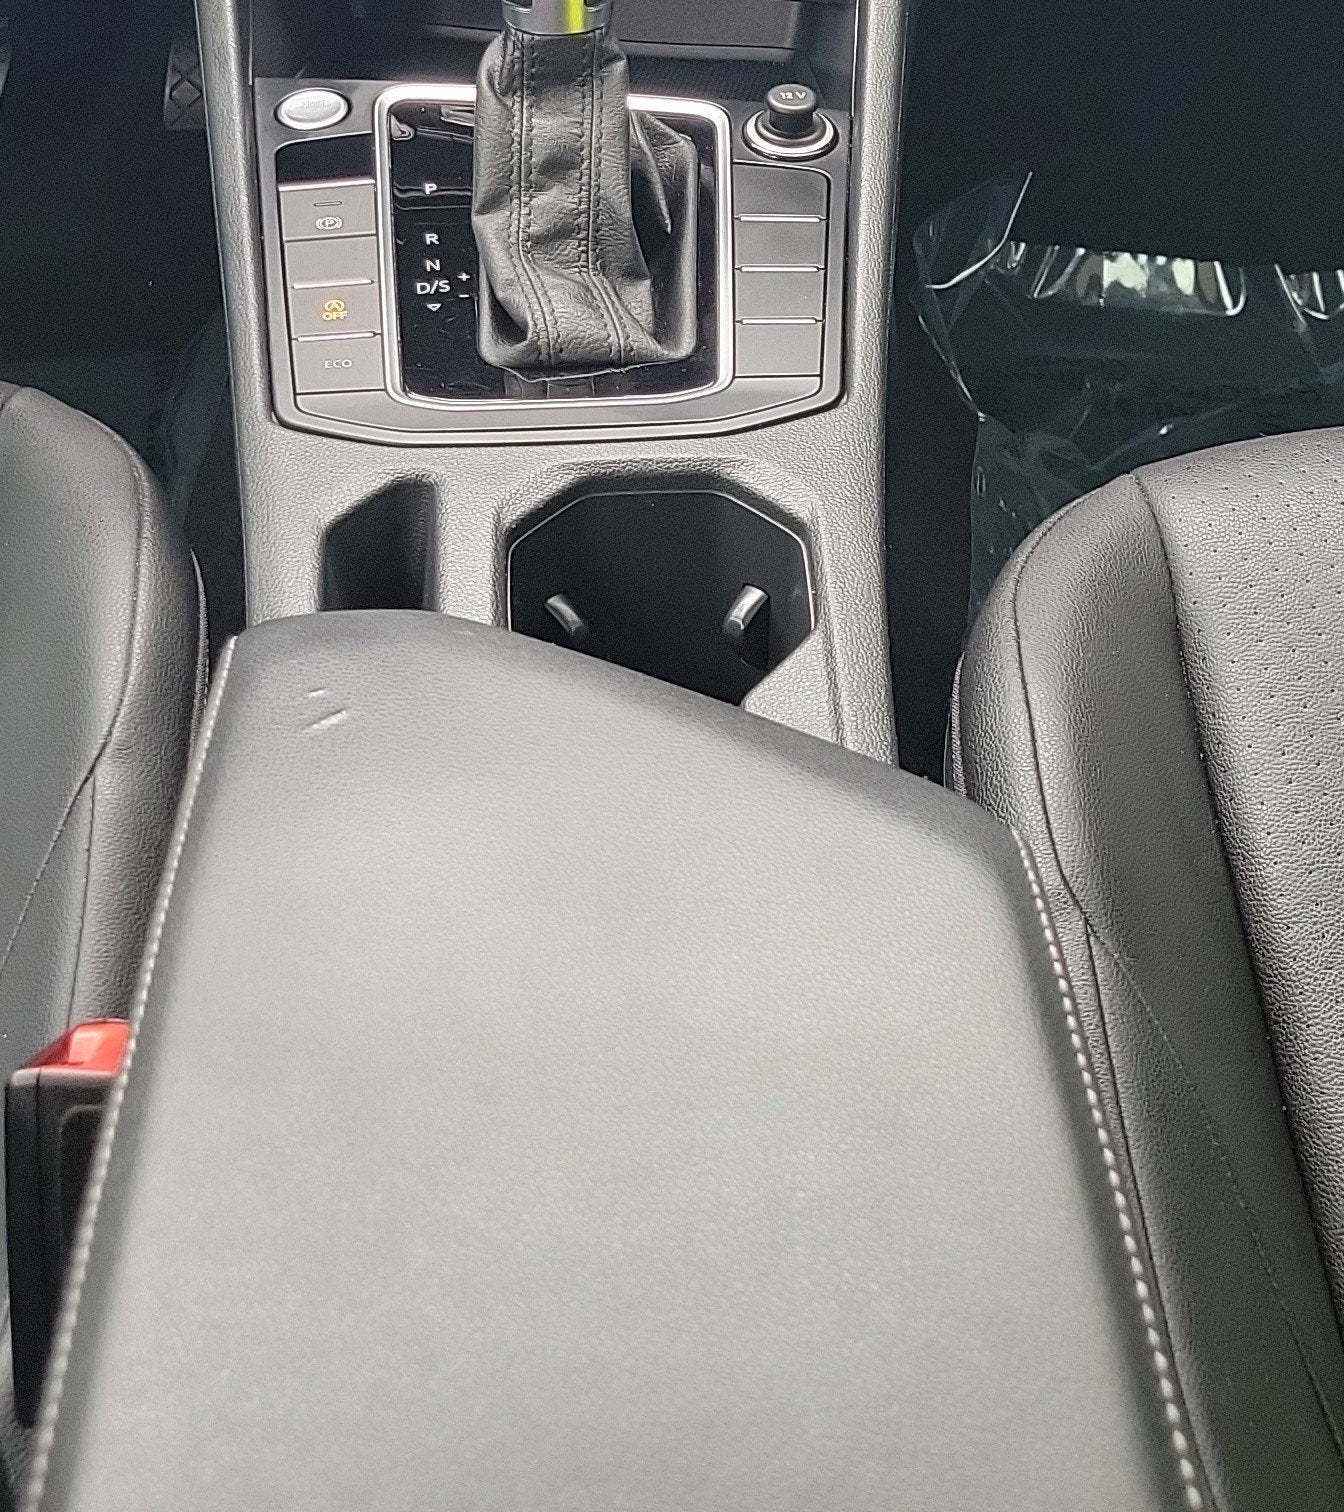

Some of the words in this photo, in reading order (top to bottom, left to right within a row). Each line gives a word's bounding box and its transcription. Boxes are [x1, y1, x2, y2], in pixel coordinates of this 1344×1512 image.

[424, 183, 438, 195] P
[424, 233, 440, 246] R
[425, 259, 441, 272] N
[416, 279, 451, 295] D/S
[321, 310, 348, 321] OFF
[324, 359, 353, 368] ECO
